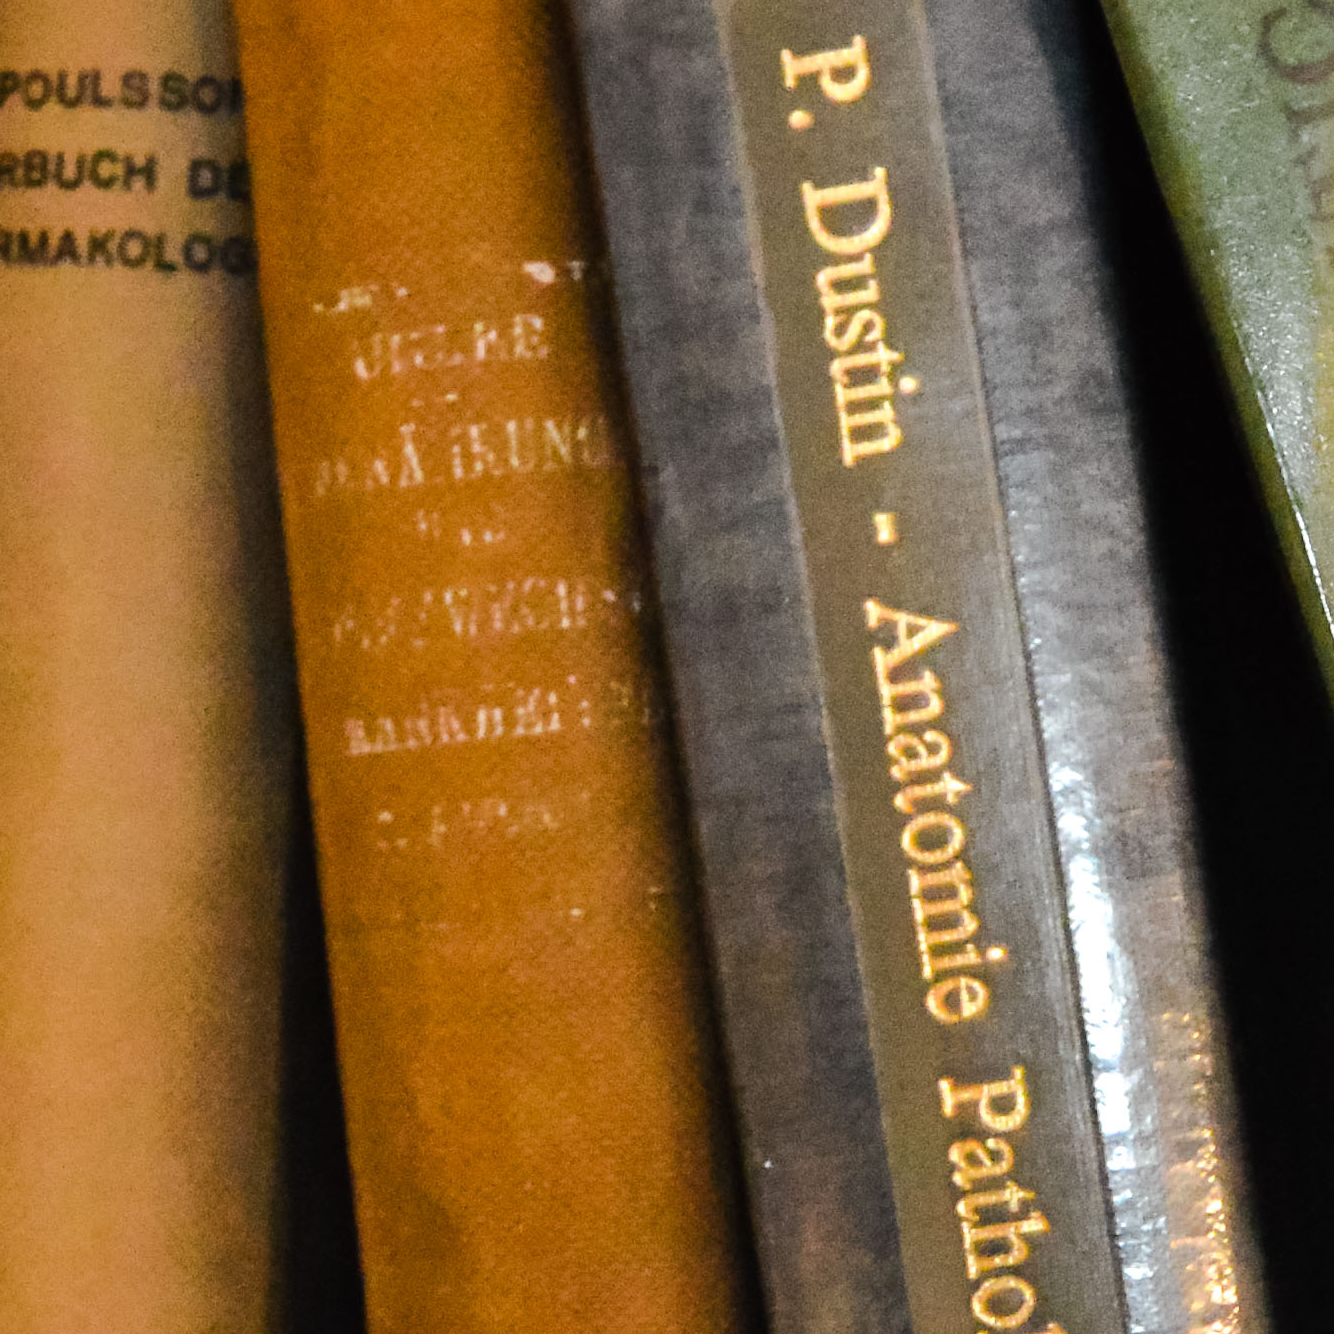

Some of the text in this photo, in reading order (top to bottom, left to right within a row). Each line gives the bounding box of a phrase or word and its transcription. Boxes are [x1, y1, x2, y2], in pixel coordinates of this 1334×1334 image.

[779, 34, 871, 130] P.
[801, 167, 919, 467] Dustin
[863, 598, 1008, 1025] Anatomie
